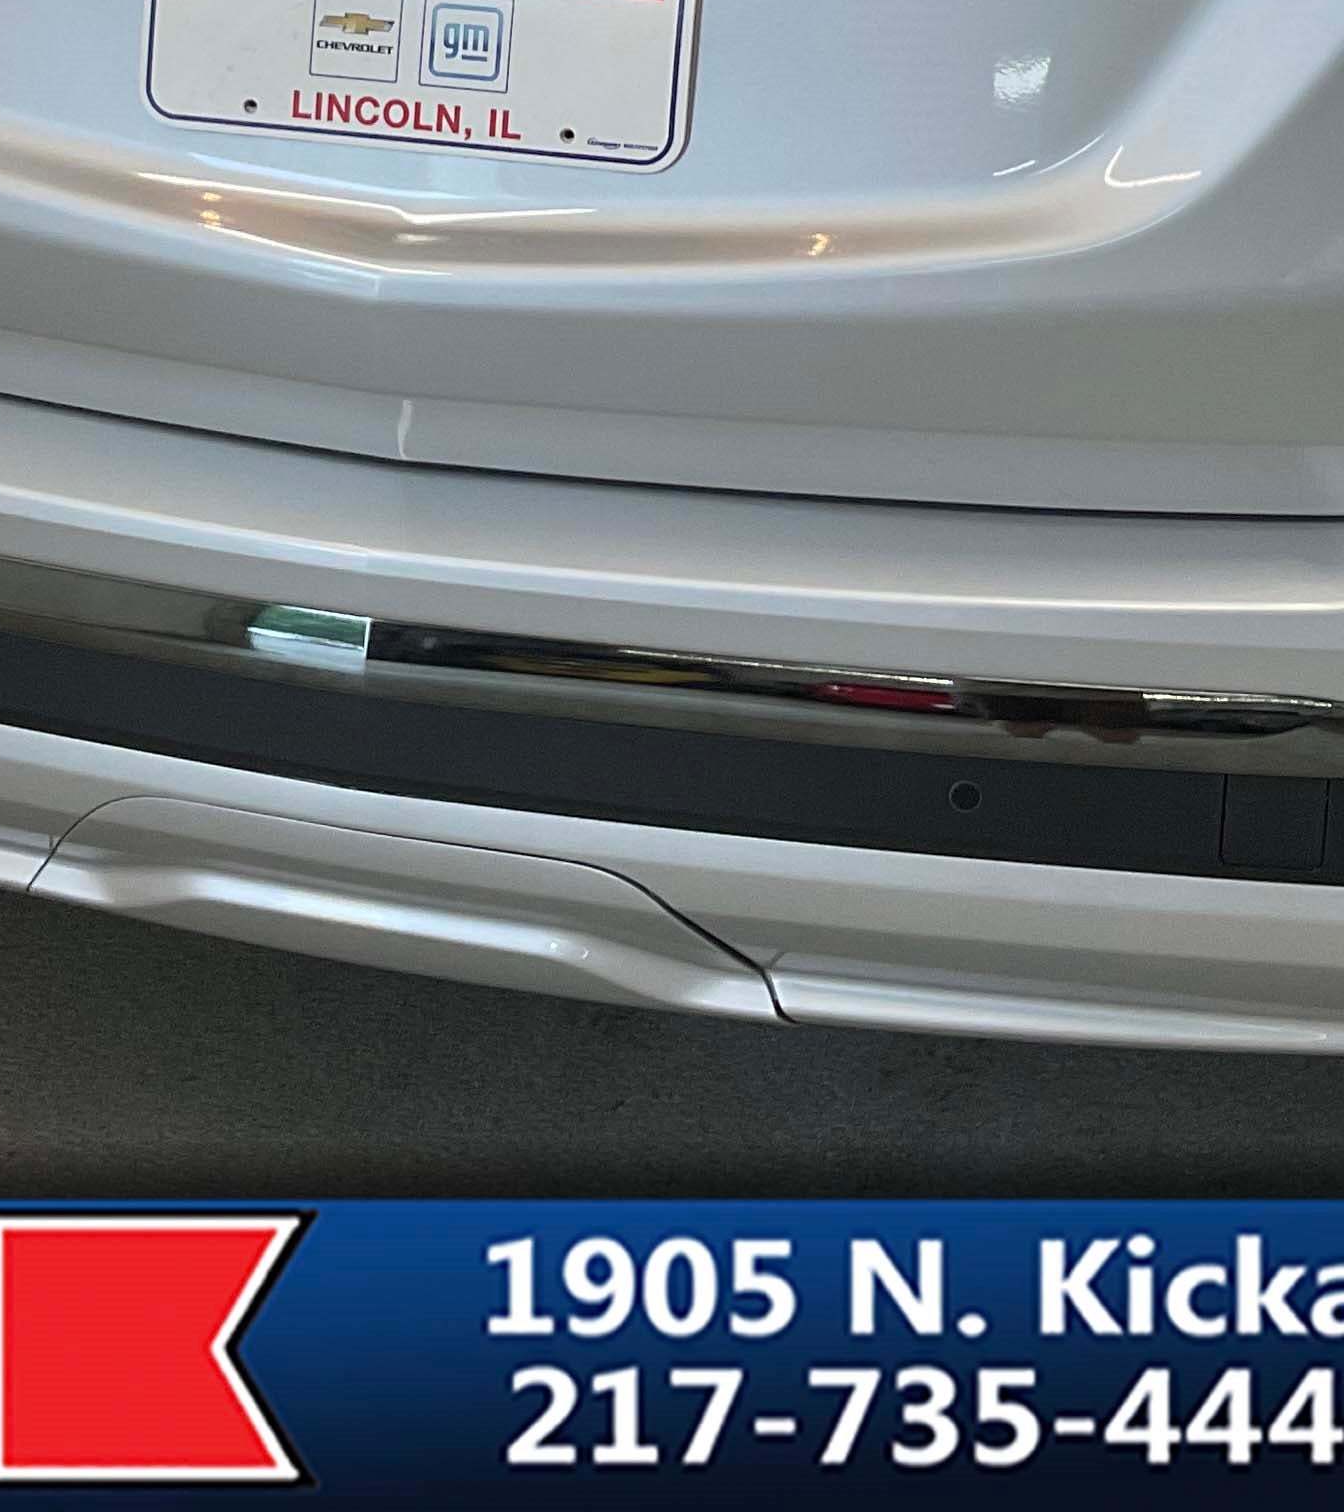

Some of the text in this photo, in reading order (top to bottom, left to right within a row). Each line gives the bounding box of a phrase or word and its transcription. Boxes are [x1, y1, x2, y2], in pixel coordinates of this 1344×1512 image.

[315, 38, 395, 57] CHEVROLET
[442, 20, 491, 63] gm
[290, 90, 523, 142] LINCOLN, IL
